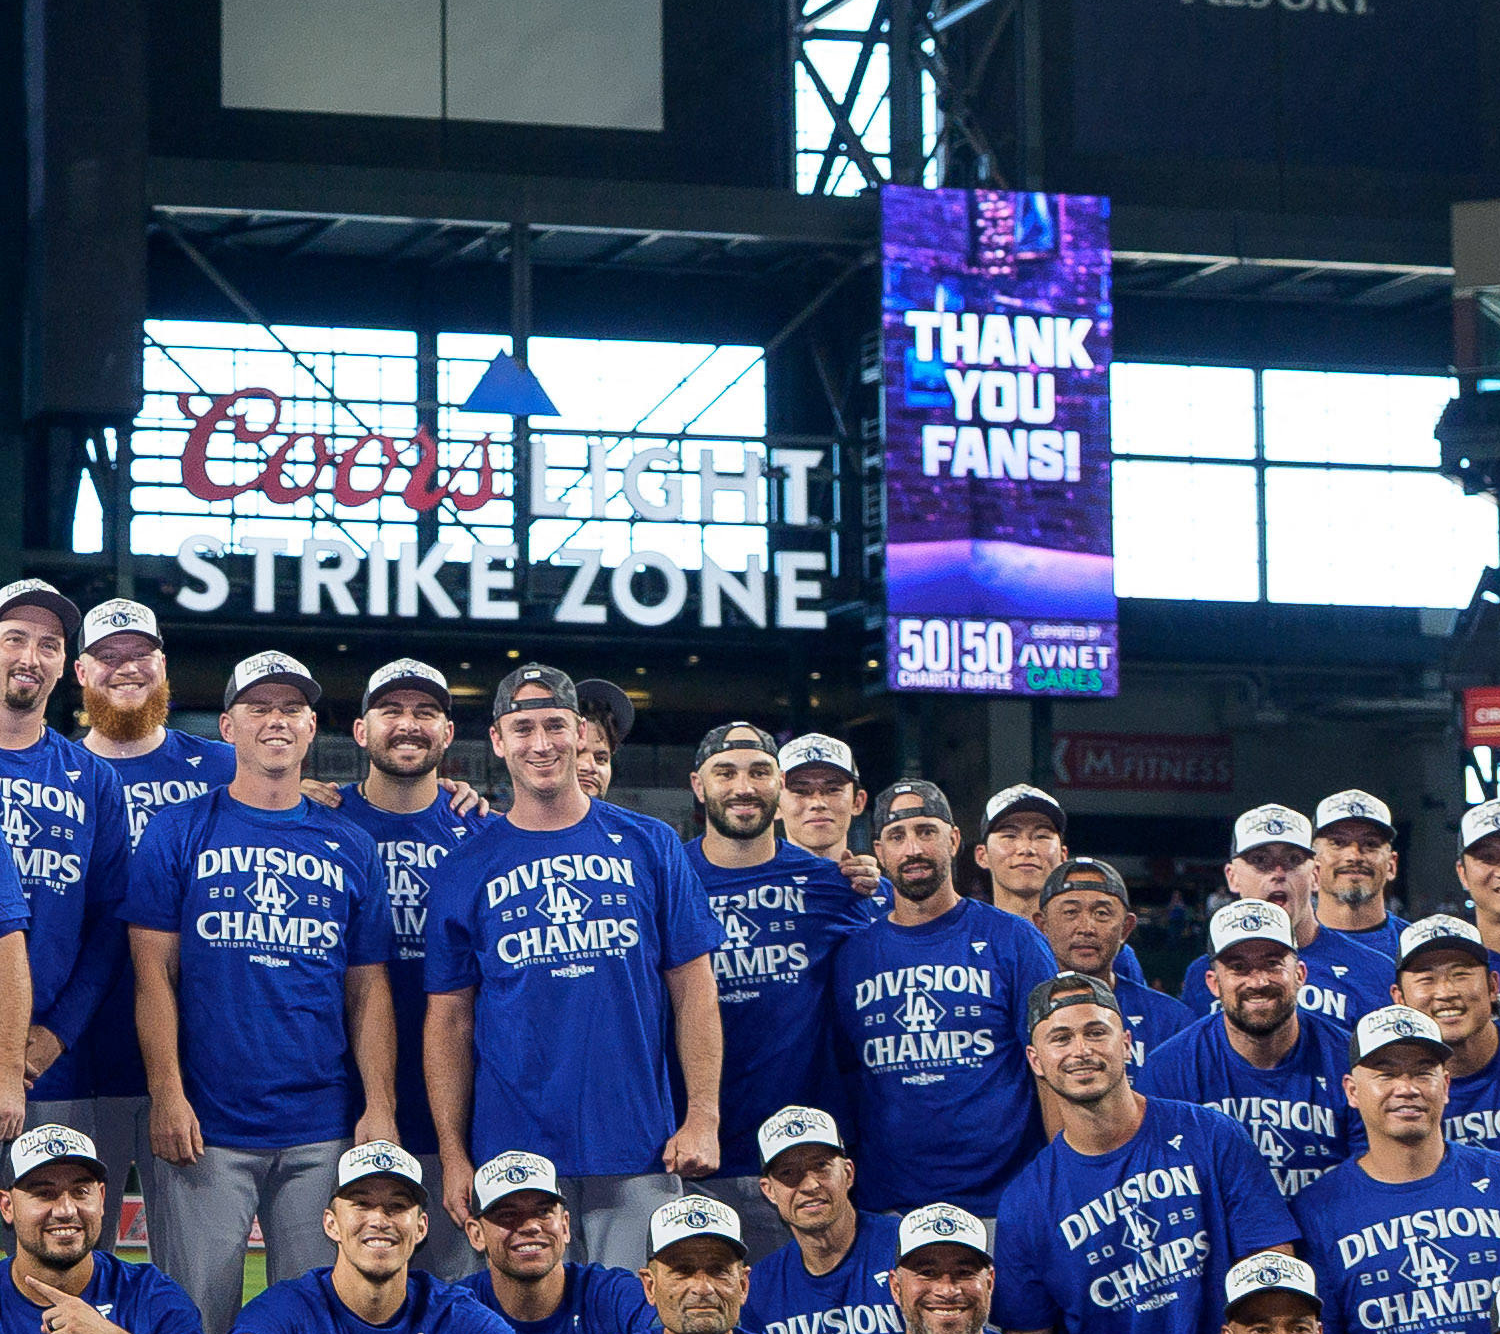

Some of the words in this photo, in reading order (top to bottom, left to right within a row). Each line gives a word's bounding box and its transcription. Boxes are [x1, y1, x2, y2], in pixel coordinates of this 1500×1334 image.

[904, 308, 1094, 372] THANK
[942, 368, 1054, 425] YOU
[177, 387, 506, 513] Coors
[529, 442, 824, 526] LIGHT
[921, 422, 1082, 483] FANS!
[175, 535, 520, 621] STRIKE
[555, 547, 828, 632] ZONE
[897, 670, 960, 688] CHARITY
[1017, 643, 1113, 670] AVNET
[1026, 667, 1104, 692] CARES
[196, 845, 344, 893] DIVISION
[485, 853, 635, 909] DIVISION
[208, 886, 236, 900] 20
[306, 894, 331, 908] 25
[500, 905, 529, 923] 20
[600, 893, 628, 907] 25
[195, 911, 340, 950] CHAMPS
[495, 918, 640, 965] CHAMPS
[855, 964, 992, 1011] DIVISION
[862, 1029, 996, 1071] CHAMPS
[1058, 1165, 1203, 1251] DIVISION
[1088, 1230, 1212, 1309] CHAMPS
